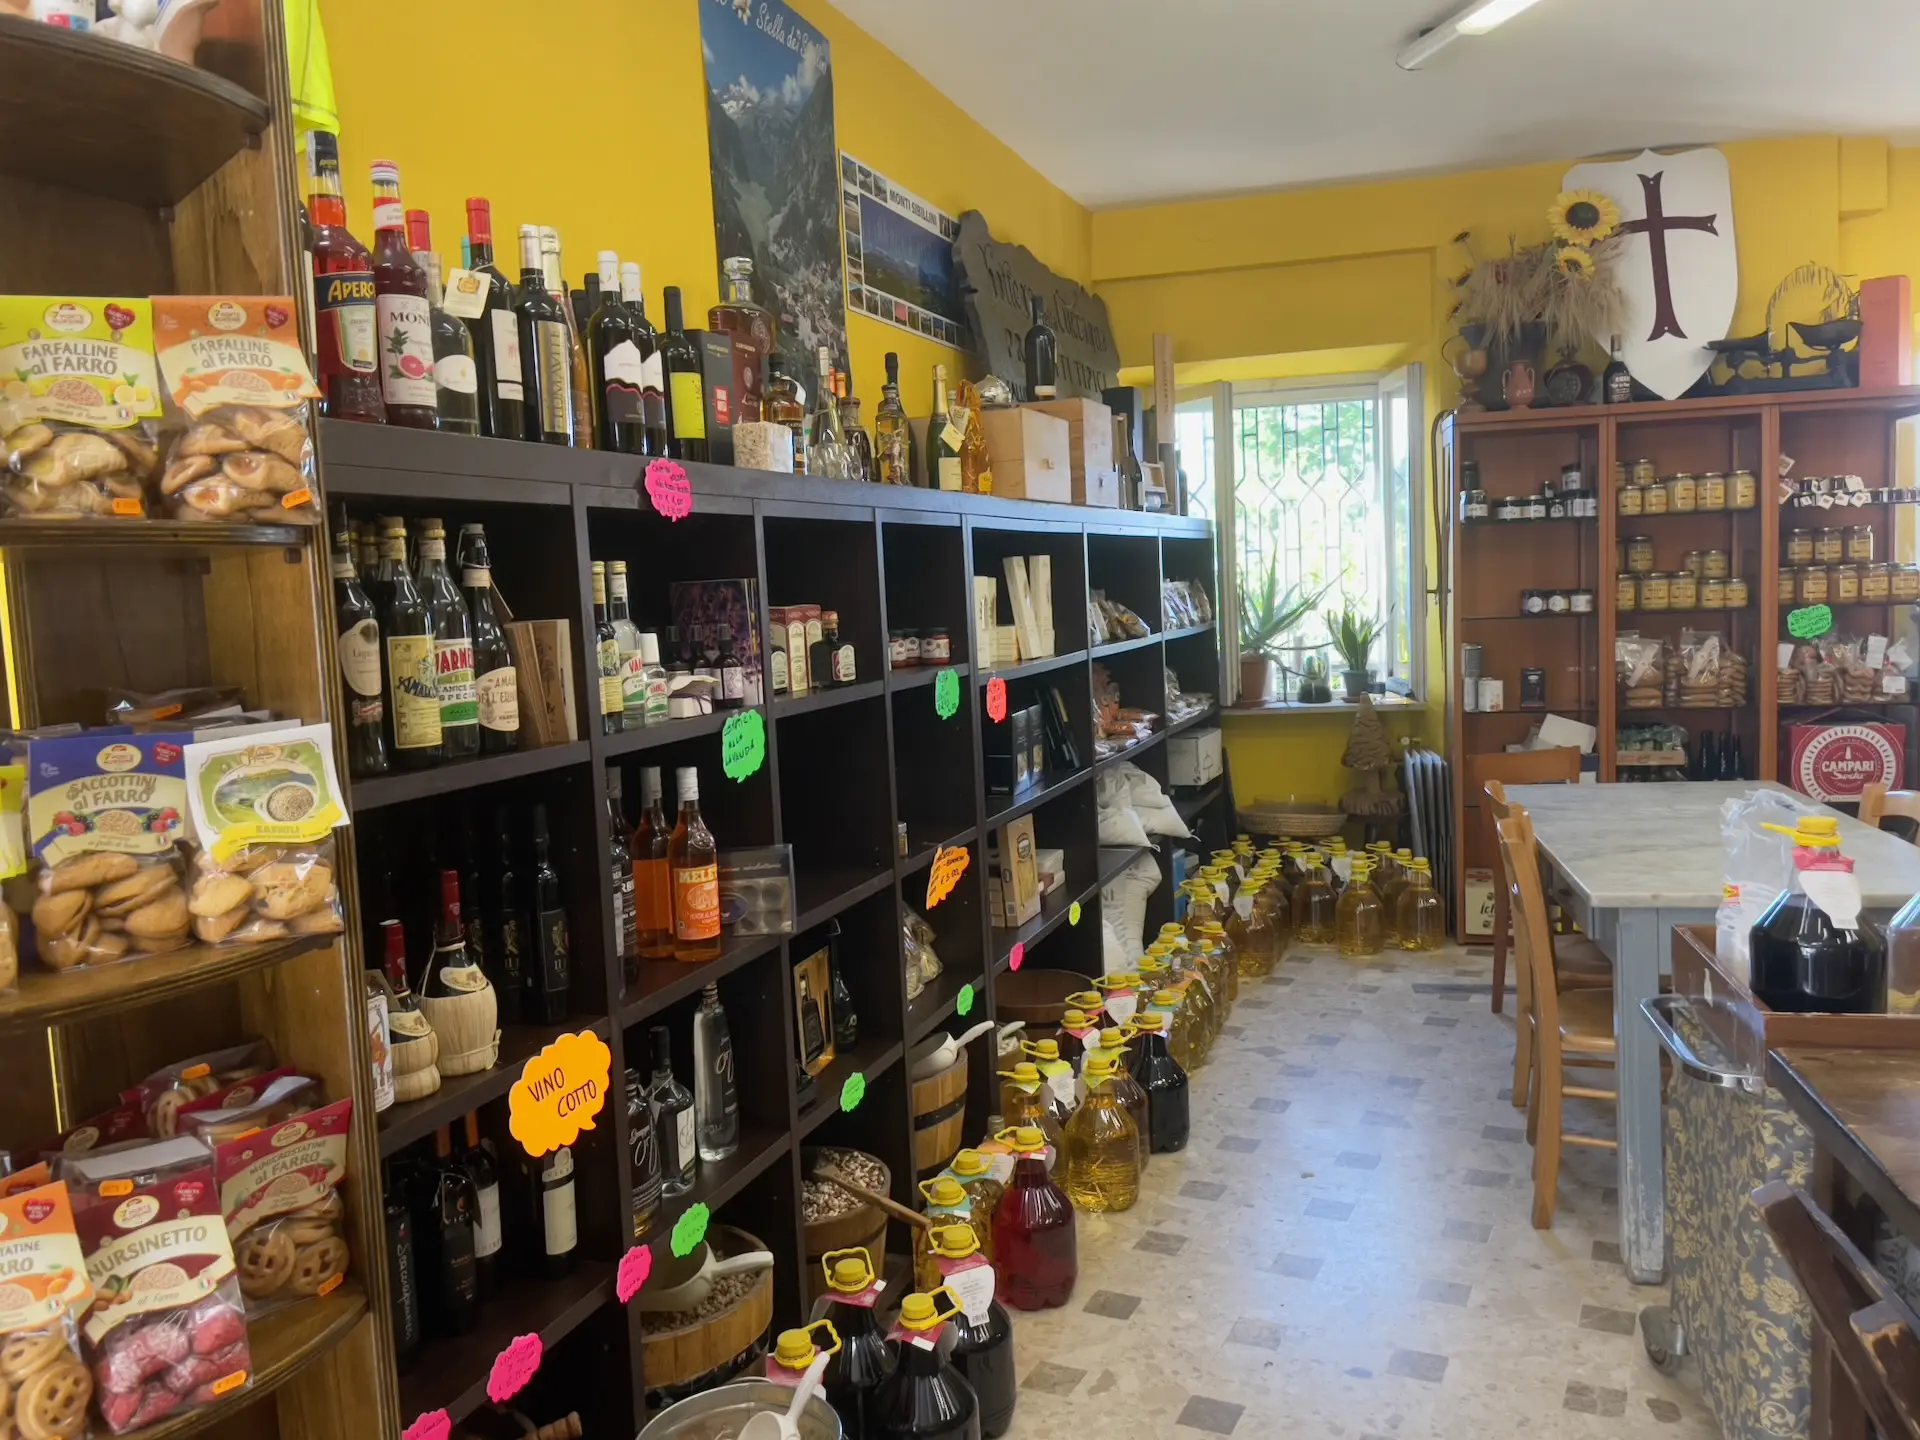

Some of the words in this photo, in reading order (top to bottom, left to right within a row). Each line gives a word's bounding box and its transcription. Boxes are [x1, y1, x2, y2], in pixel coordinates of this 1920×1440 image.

[756, 2, 785, 45] Stella
[889, 188, 911, 213] MONTI
[327, 279, 376, 303] APERO
[21, 342, 119, 361] FARFALLINE
[191, 339, 271, 356] FARFALLINE
[201, 356, 216, 369] al
[219, 351, 274, 369] FARRO
[31, 361, 48, 376] al
[52, 356, 118, 375] FARRO
[1821, 760, 1875, 773] CAMPARI
[66, 774, 158, 800] SACCOTTINI
[73, 794, 89, 813] al
[93, 788, 151, 806] FARRO
[527, 1067, 565, 1103] VINO
[557, 1079, 597, 1118] COTTO
[271, 1150, 321, 1176] FARRO
[89, 1225, 208, 1282] NURSINETTO
